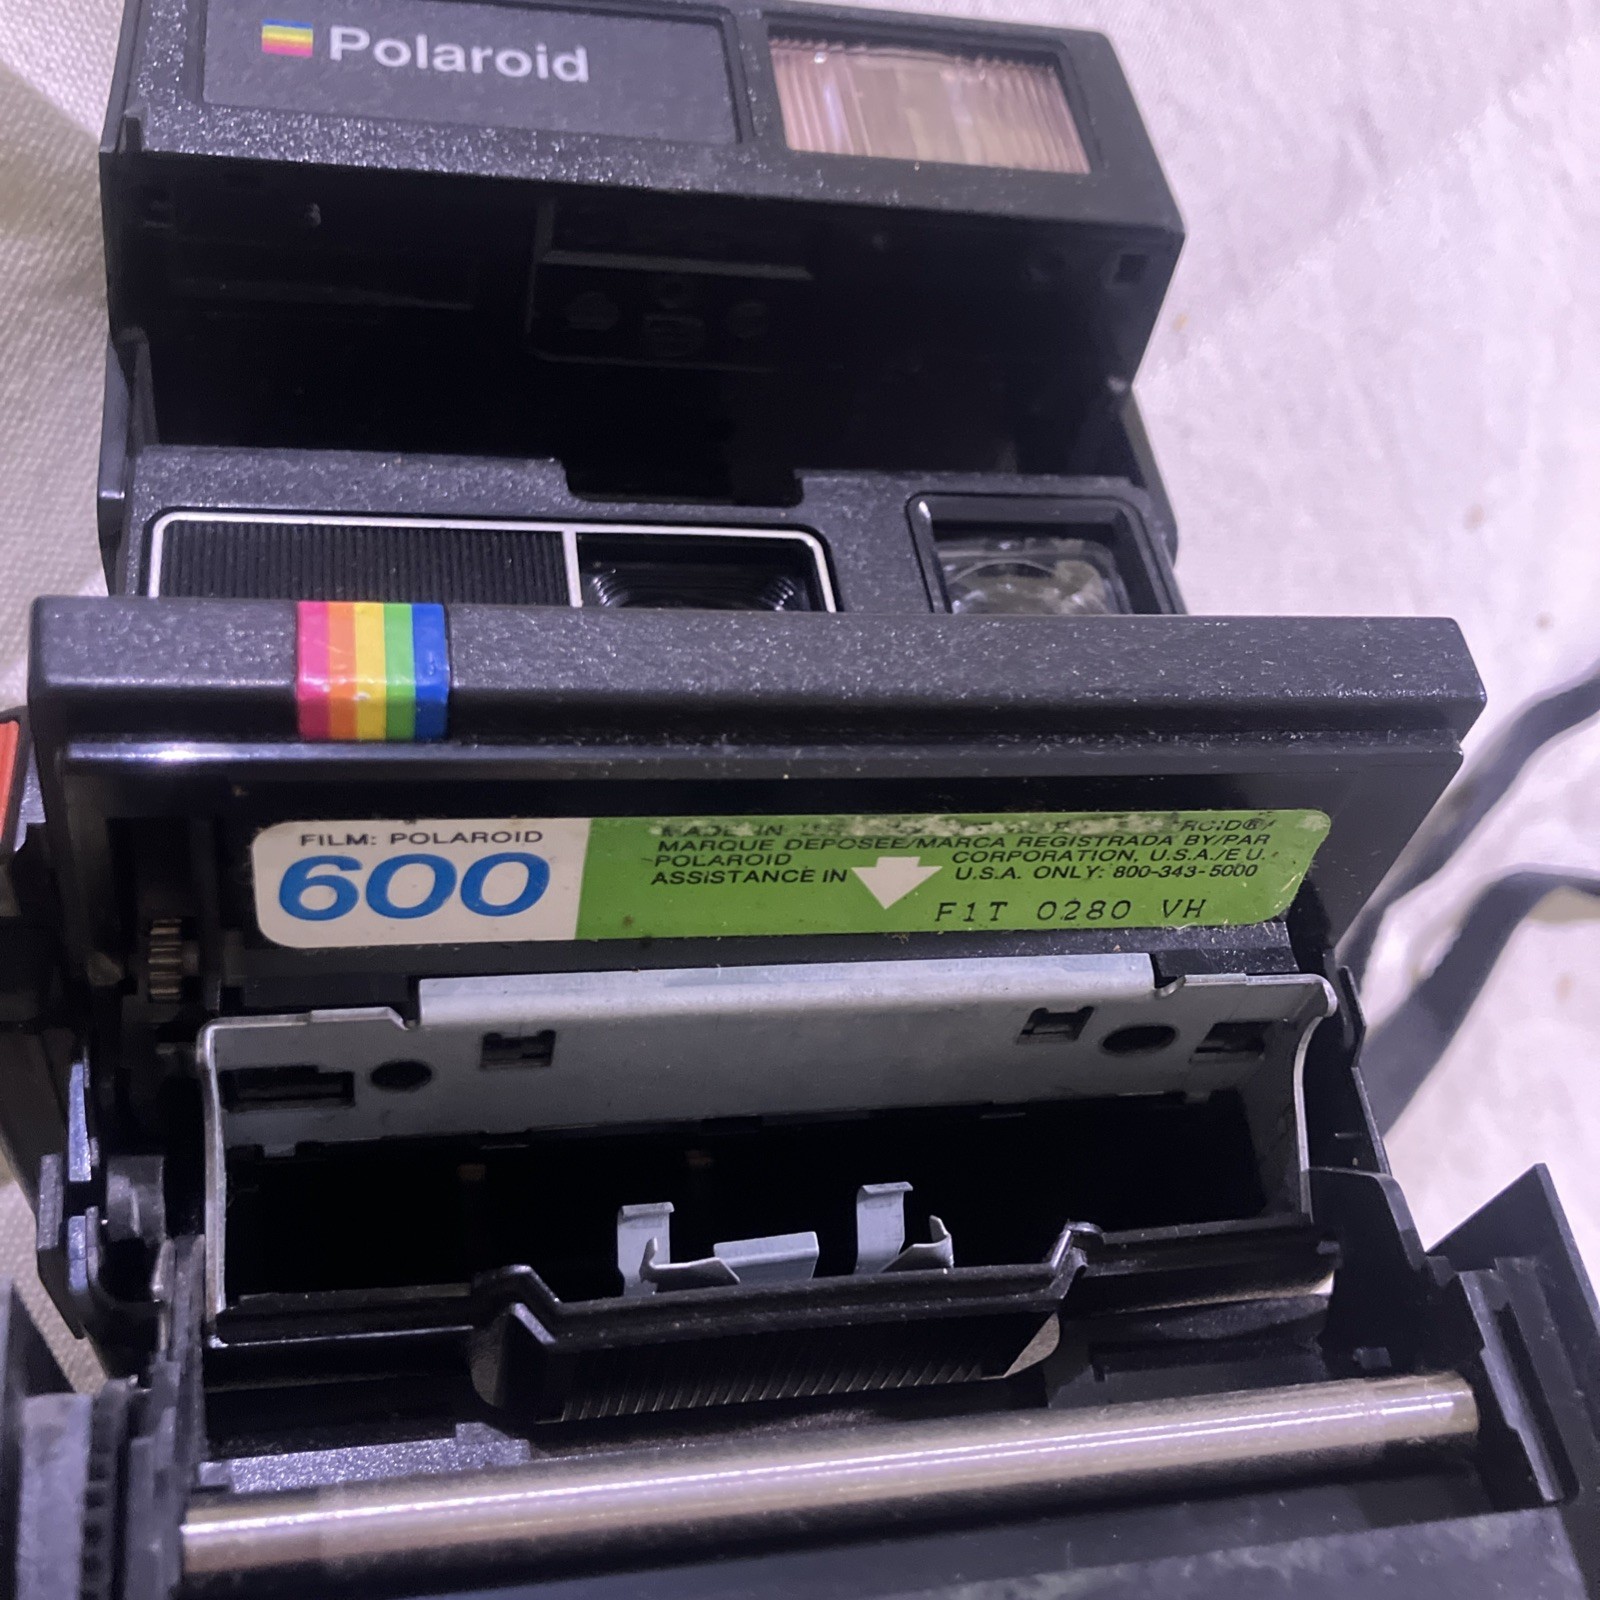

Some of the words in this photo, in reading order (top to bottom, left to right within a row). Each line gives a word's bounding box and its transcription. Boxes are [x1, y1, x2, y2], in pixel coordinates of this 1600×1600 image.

[329, 25, 589, 83] Polaroid
[300, 834, 377, 846] FILM:
[390, 831, 543, 845] POLAROID
[658, 840, 775, 852] MARQUE
[784, 838, 1005, 850] DEPOSEE/MARCA
[1016, 835, 1172, 847] REGISTRADA
[1183, 834, 1270, 846] BY/PAR
[655, 854, 792, 867] POLAROID
[952, 850, 1138, 863] CORPORATION,
[651, 870, 815, 885] ASSISTANCE
[823, 869, 847, 883] IN
[955, 867, 1021, 880] U.S.A.
[1033, 865, 1104, 879] ONLY:
[1113, 864, 1258, 878] 800-343-5000
[278, 852, 551, 922] 600
[935, 902, 1008, 922] F1T
[1036, 900, 1132, 920] 0280
[1162, 897, 1207, 918] VH
